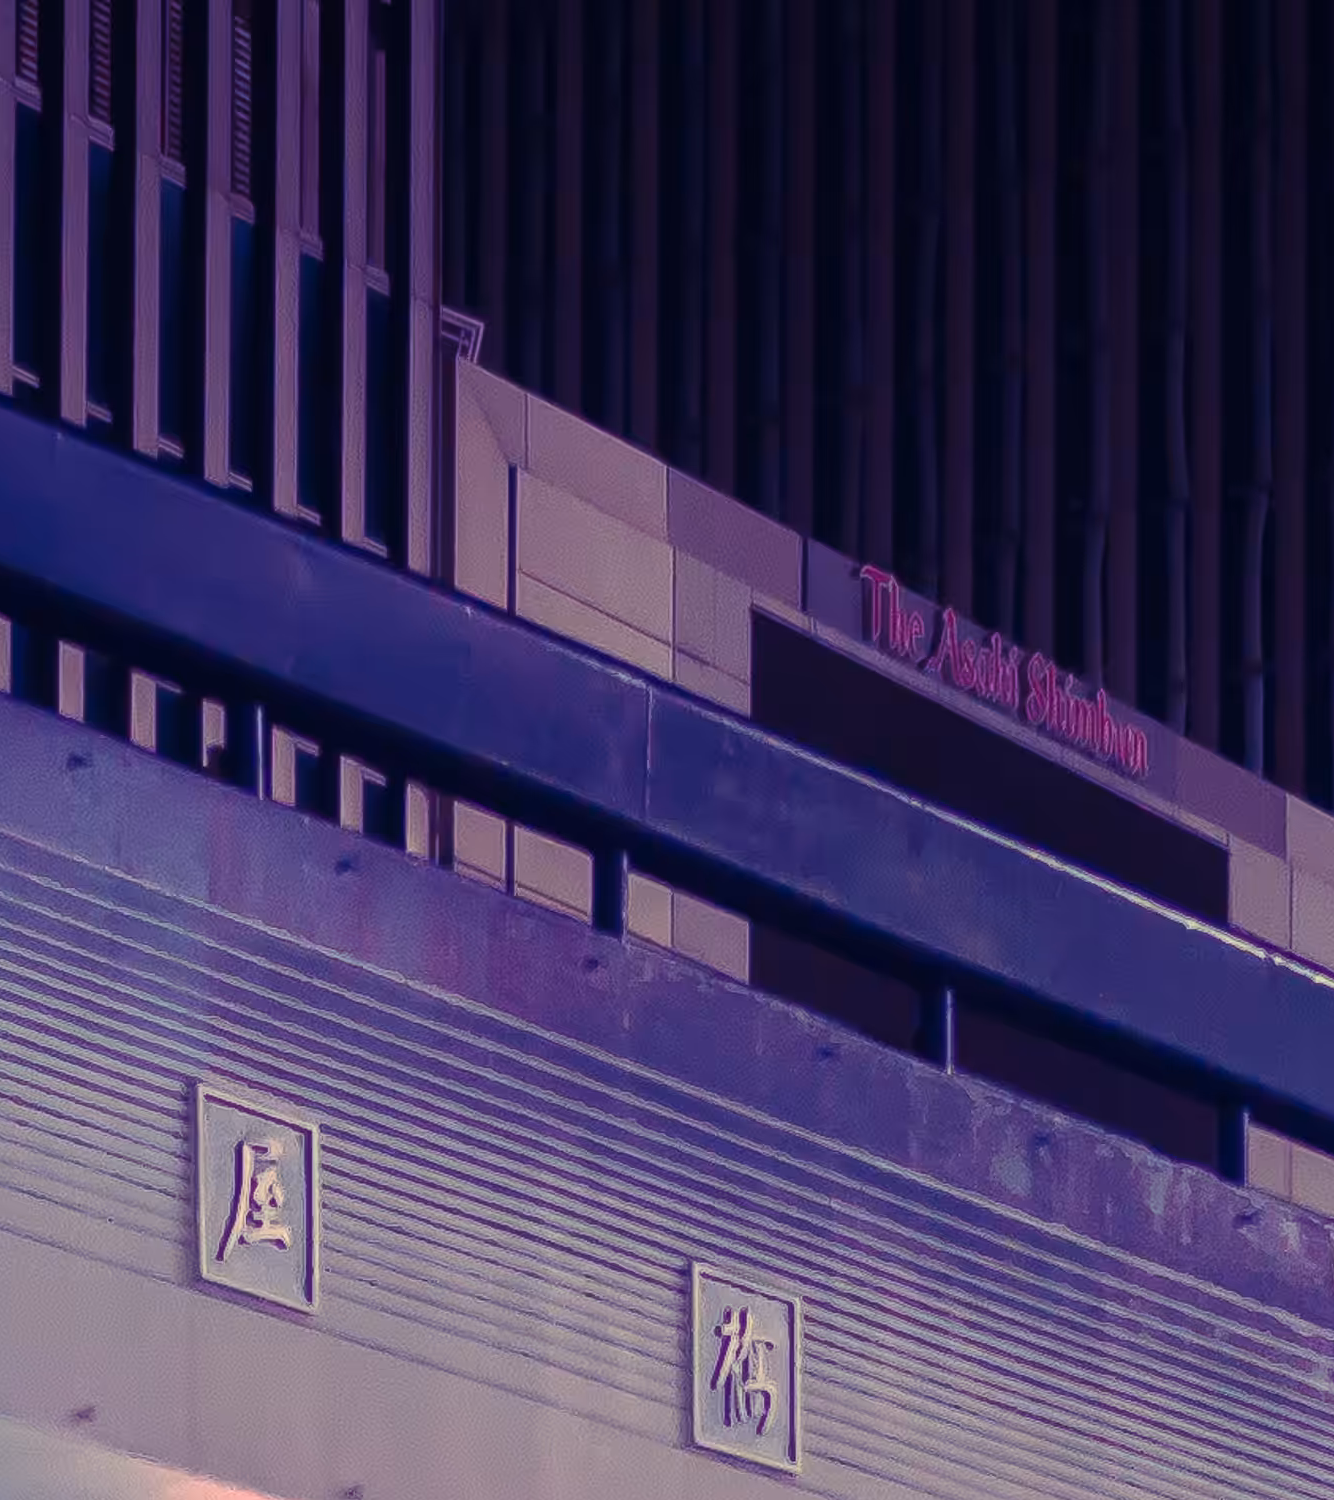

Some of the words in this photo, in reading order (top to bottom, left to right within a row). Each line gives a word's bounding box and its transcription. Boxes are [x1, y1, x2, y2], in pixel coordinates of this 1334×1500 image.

[860, 564, 924, 661] The
[924, 608, 1019, 708] Asahi
[1026, 652, 1147, 776] Shimbun
